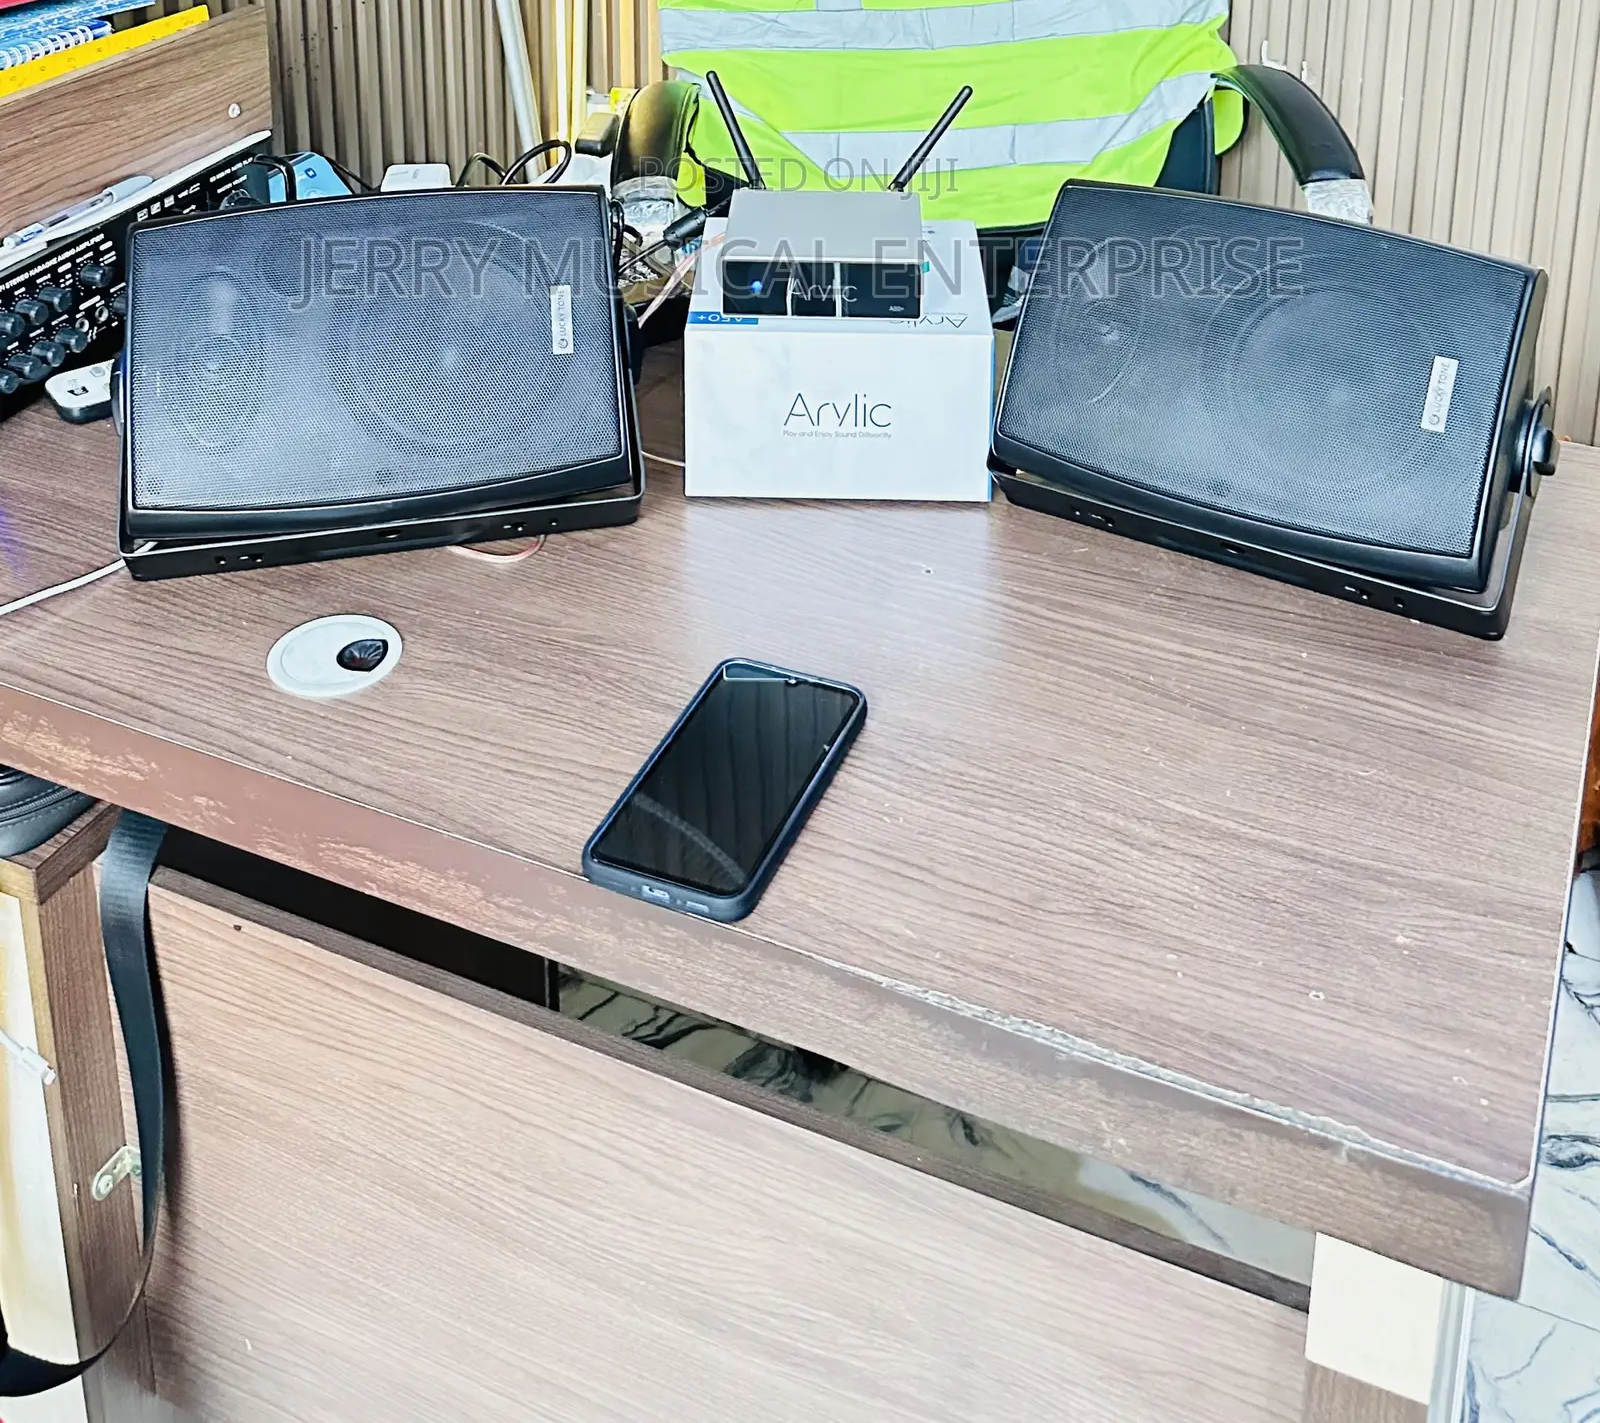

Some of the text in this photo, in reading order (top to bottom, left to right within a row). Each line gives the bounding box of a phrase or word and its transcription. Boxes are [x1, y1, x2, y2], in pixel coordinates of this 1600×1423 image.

[29, 257, 57, 277] KARAOKE
[58, 248, 76, 262] AUDIO
[76, 233, 104, 253] AMPLIFIER
[557, 290, 567, 336] LUCKY TONE
[784, 393, 892, 427] Arylic
[783, 430, 797, 438] Play
[815, 430, 833, 438] Enjoy
[835, 430, 857, 438] Sound
